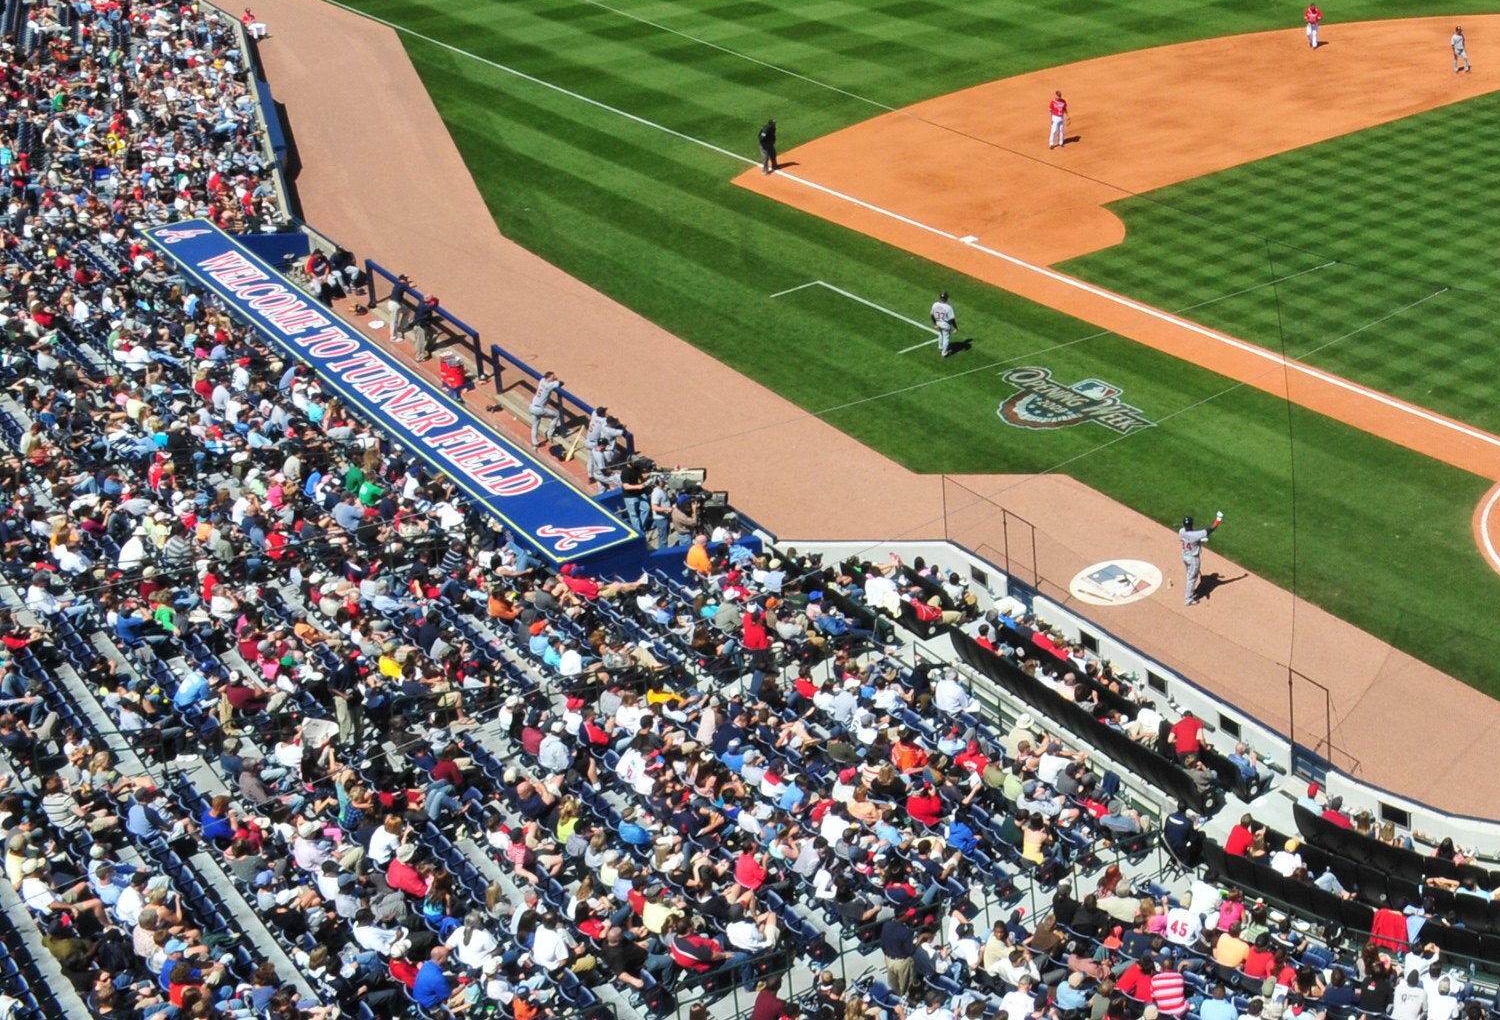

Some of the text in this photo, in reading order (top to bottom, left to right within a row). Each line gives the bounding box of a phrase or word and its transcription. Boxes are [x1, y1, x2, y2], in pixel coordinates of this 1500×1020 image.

[196, 250, 544, 497] WELCOME TO TURNER FIELD
[1009, 367, 1090, 407] OPENING
[1081, 397, 1144, 431] WEEK
[1170, 919, 1189, 937] 45
